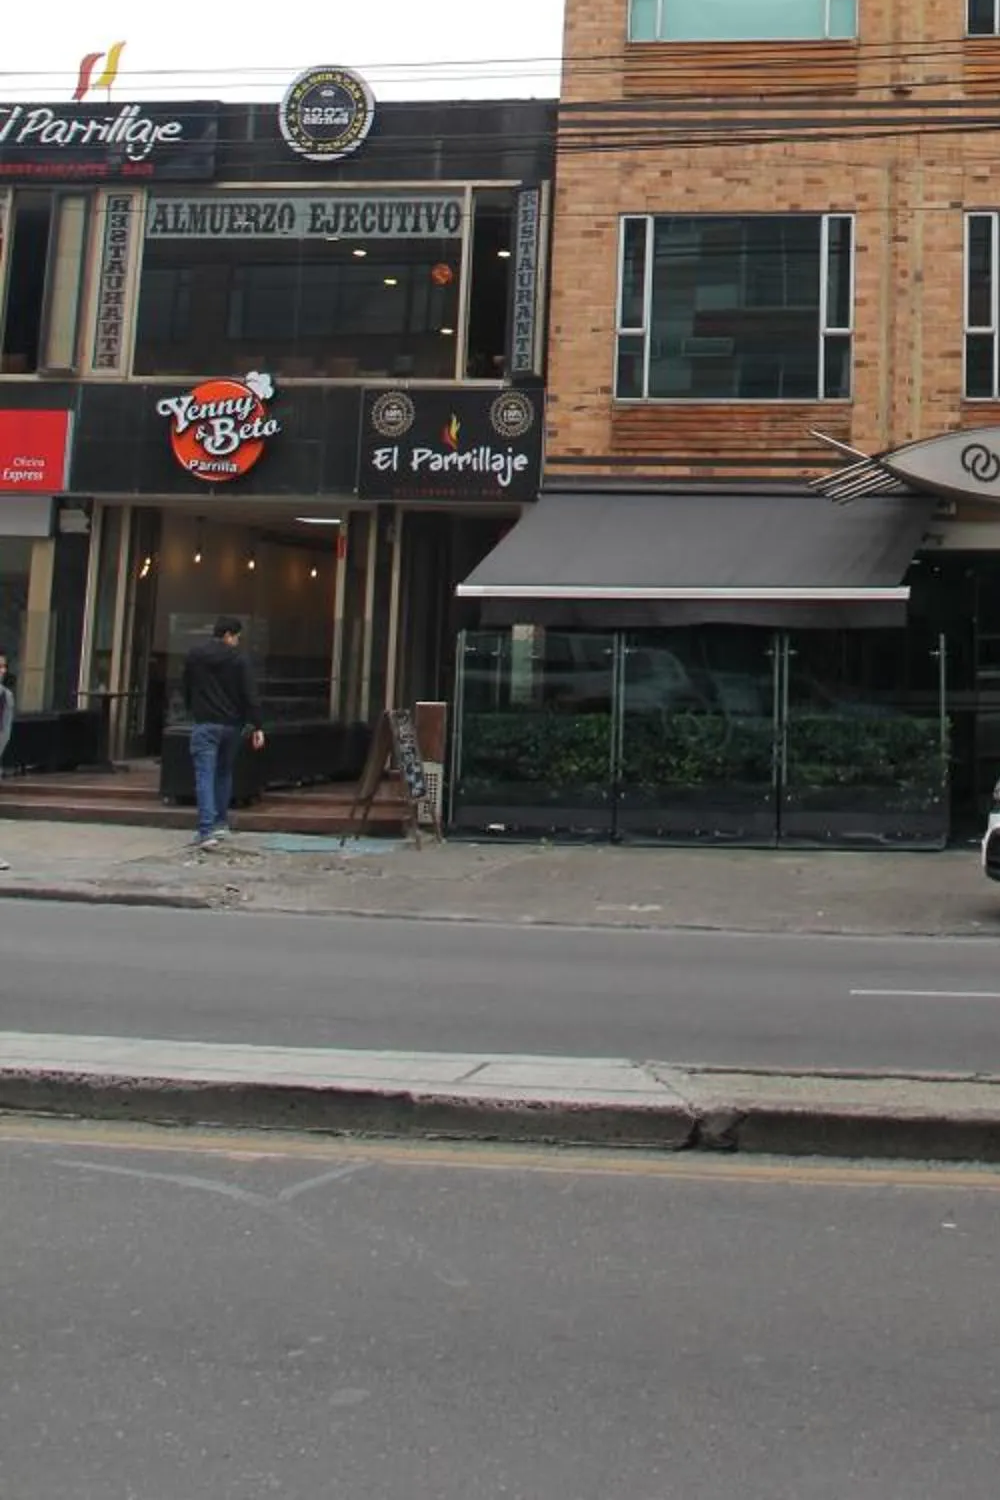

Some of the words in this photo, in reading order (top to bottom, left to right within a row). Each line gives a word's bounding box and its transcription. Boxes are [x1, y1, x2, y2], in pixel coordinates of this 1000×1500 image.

[16, 105, 184, 161] Parrillaje
[150, 202, 296, 234] ALMUERZO
[307, 201, 462, 234] EJECUTIVO
[514, 194, 536, 369] RESTAURANTE
[156, 395, 255, 433] Yenny
[203, 417, 281, 455] Beto
[187, 459, 238, 473] Parrilla
[371, 446, 399, 472] El
[410, 446, 529, 487] Parrillaje
